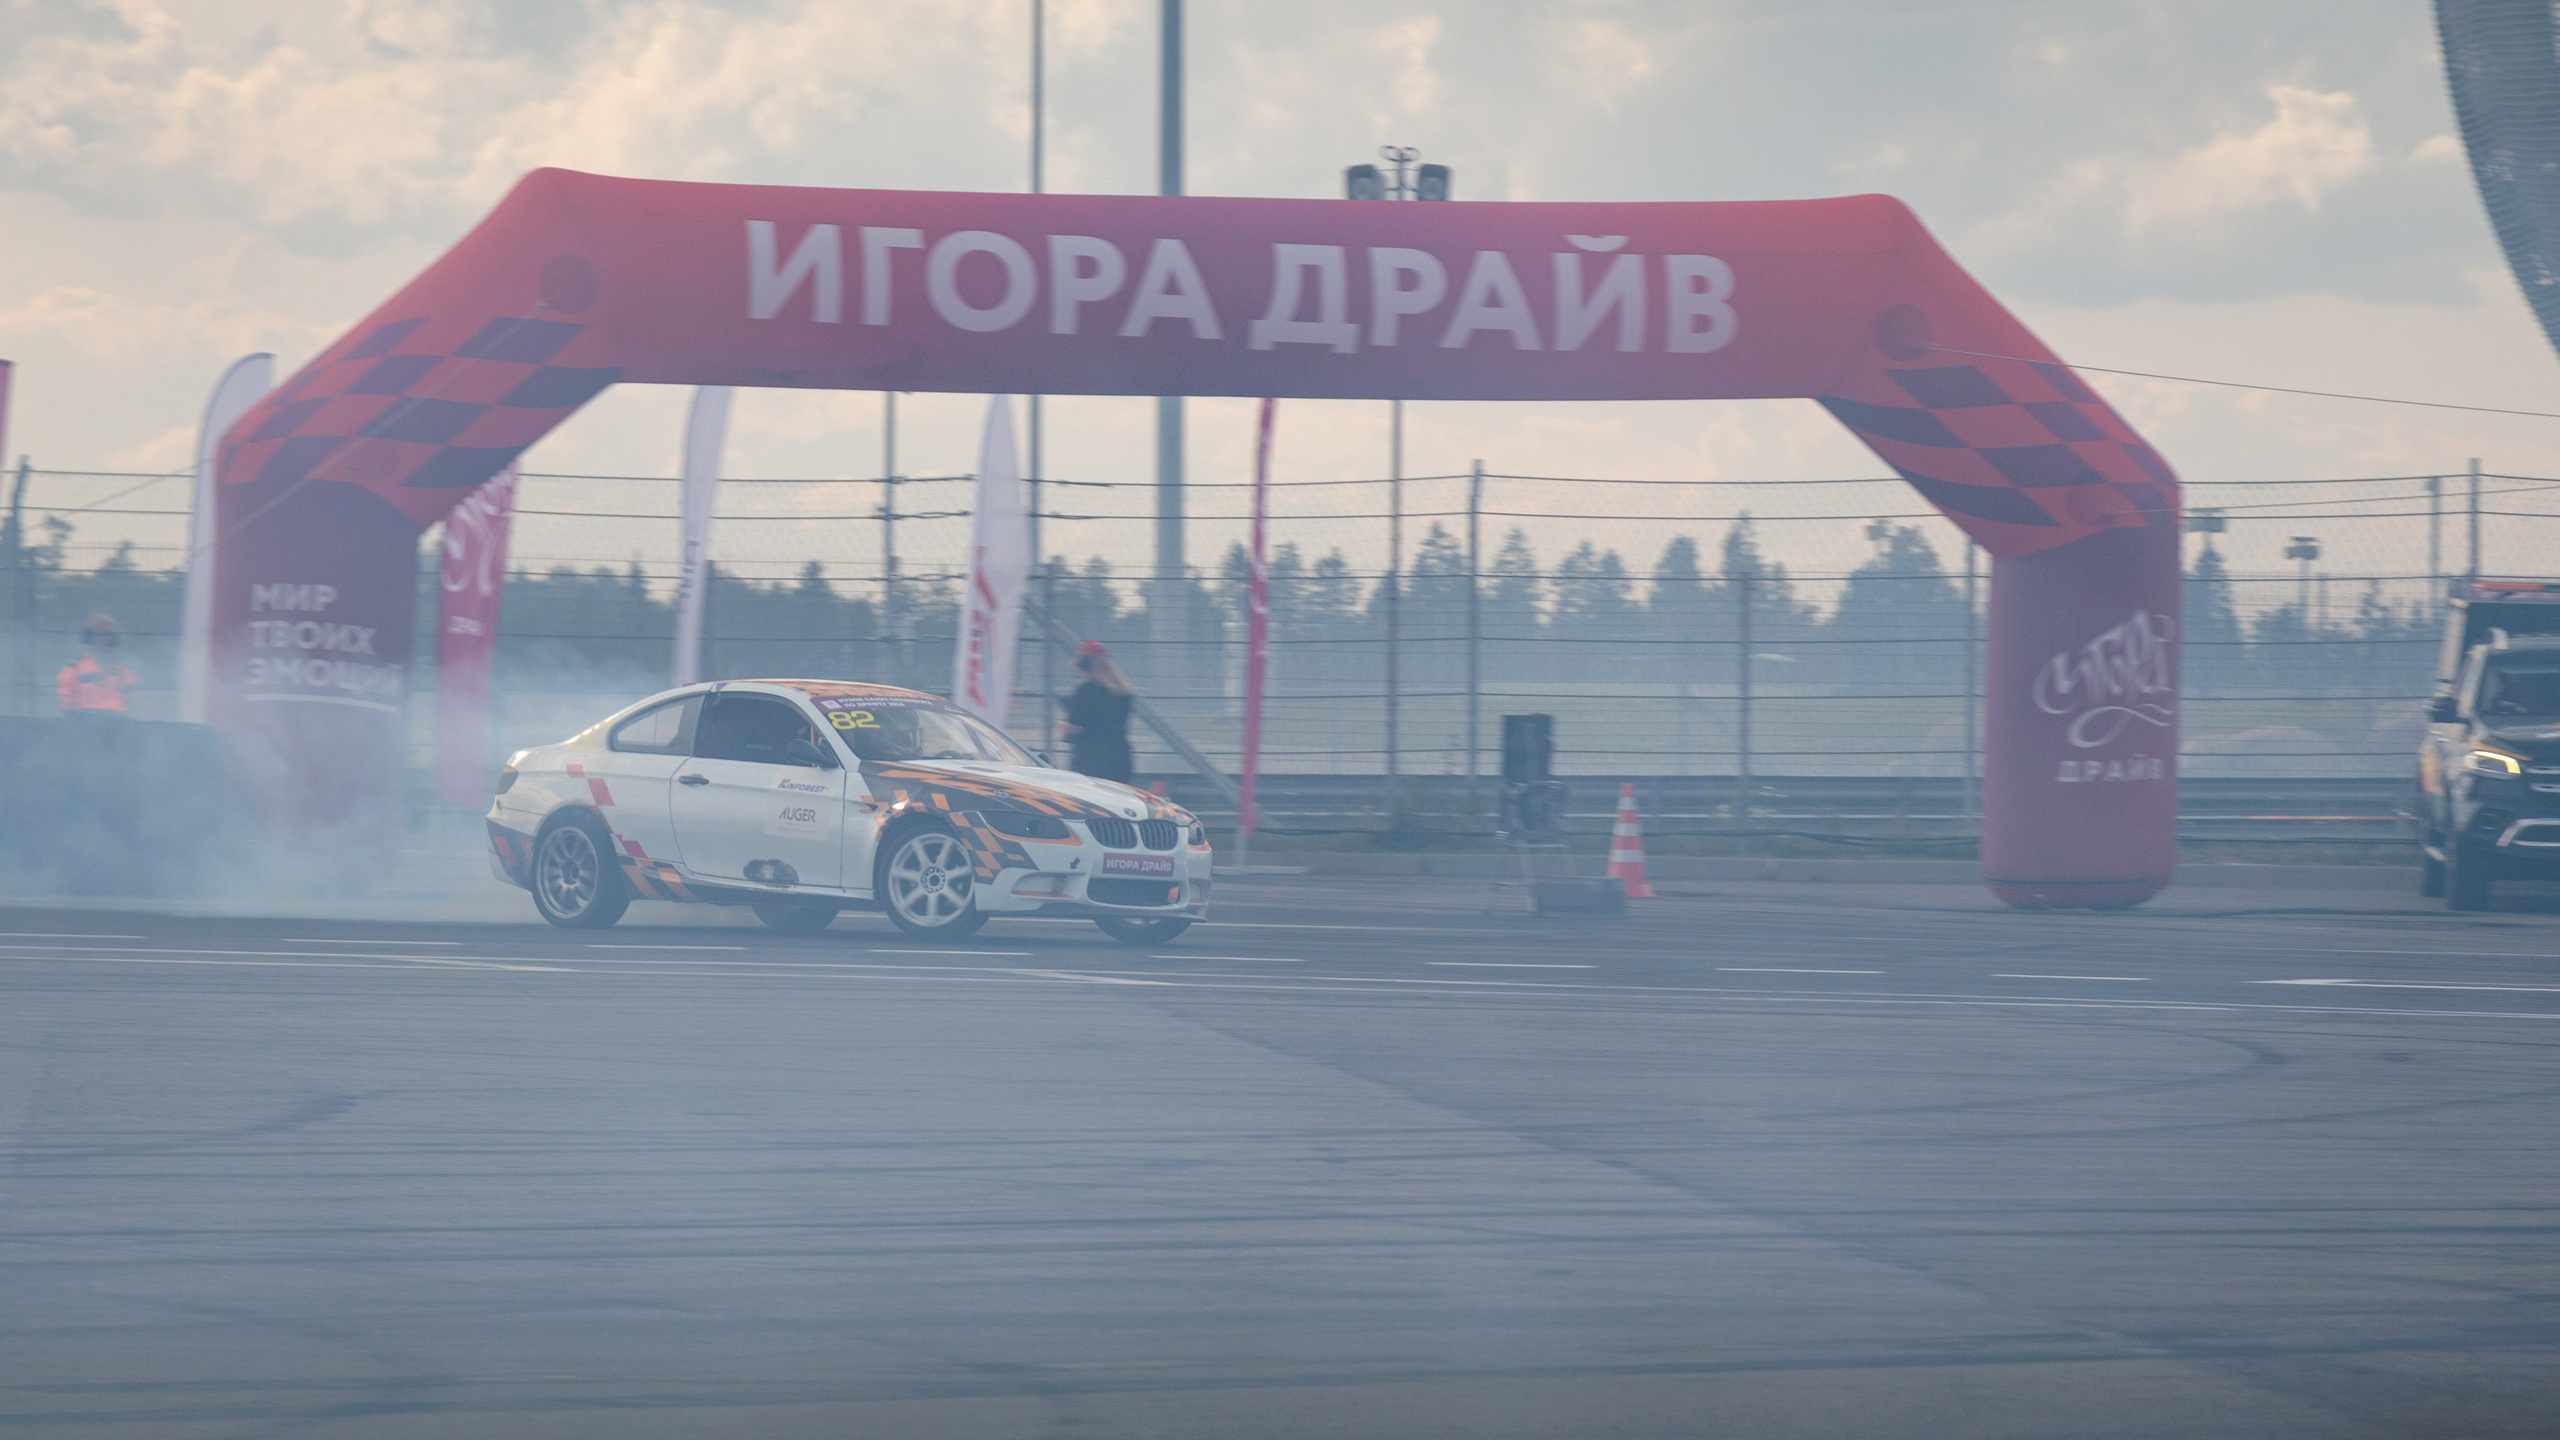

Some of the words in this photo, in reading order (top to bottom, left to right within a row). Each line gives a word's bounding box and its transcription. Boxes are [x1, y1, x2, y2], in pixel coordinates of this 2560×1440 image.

[745, 220, 1224, 339] ИГОРА
[1246, 234, 1739, 354] ДРАЙВ
[251, 583, 339, 612] МИР
[247, 620, 378, 655] ТВОИХ
[246, 657, 403, 696] ЭМОЦИЙ
[827, 710, 880, 730] 82
[2055, 753, 2164, 782] ДРАЙВ
[777, 778, 827, 793] KINFOREST
[779, 807, 816, 823] AUGER
[1106, 859, 1140, 870] ИГОРА
[1141, 860, 1172, 872] ДРАЙВ
